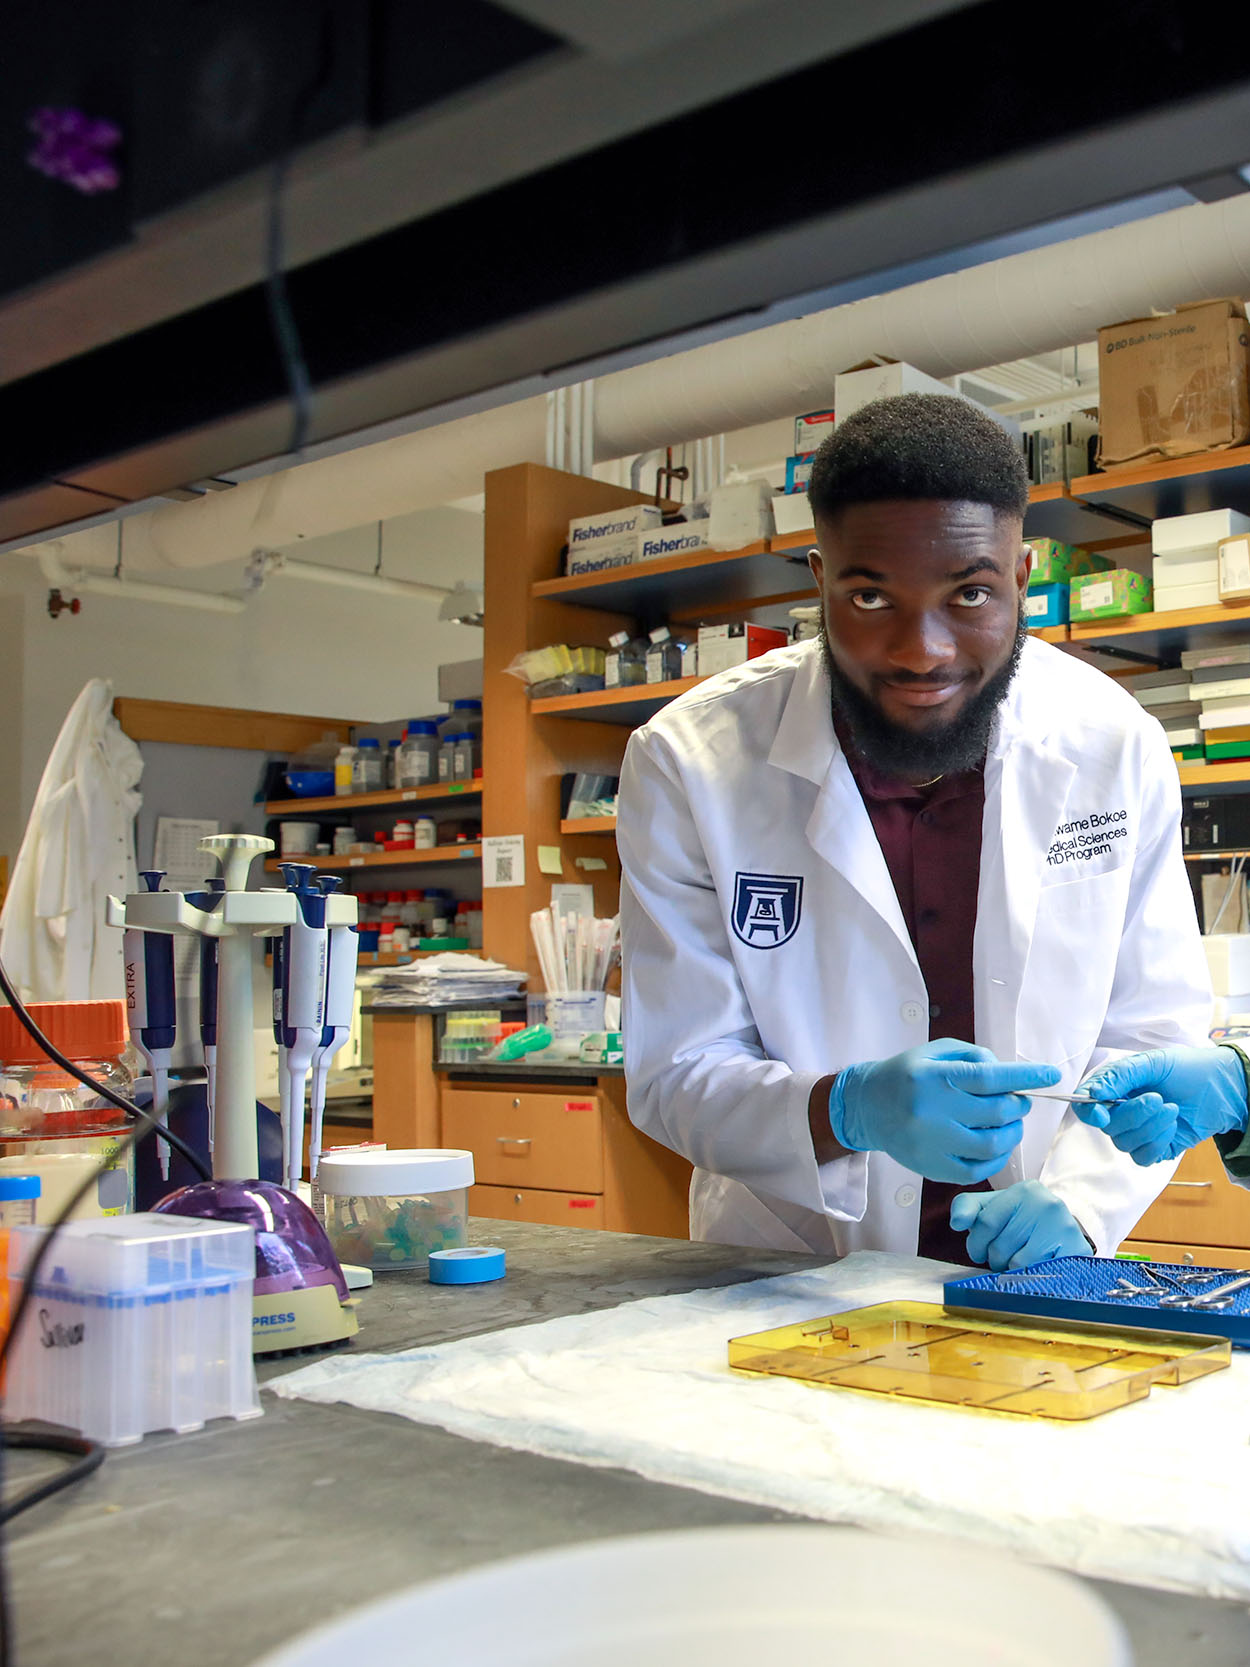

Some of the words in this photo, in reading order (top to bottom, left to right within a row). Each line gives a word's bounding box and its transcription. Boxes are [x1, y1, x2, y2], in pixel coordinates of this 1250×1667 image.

[572, 516, 637, 542] Fisherbrand
[643, 534, 701, 556] Fisherbra
[571, 551, 633, 576] Fisherbrand
[1054, 819, 1089, 836] wame
[1090, 809, 1127, 828] Bokoe
[1077, 827, 1127, 847] Sciences
[1064, 843, 1112, 862] Program
[126, 962, 136, 1009] EXTRA
[252, 1312, 296, 1327] PRESS
